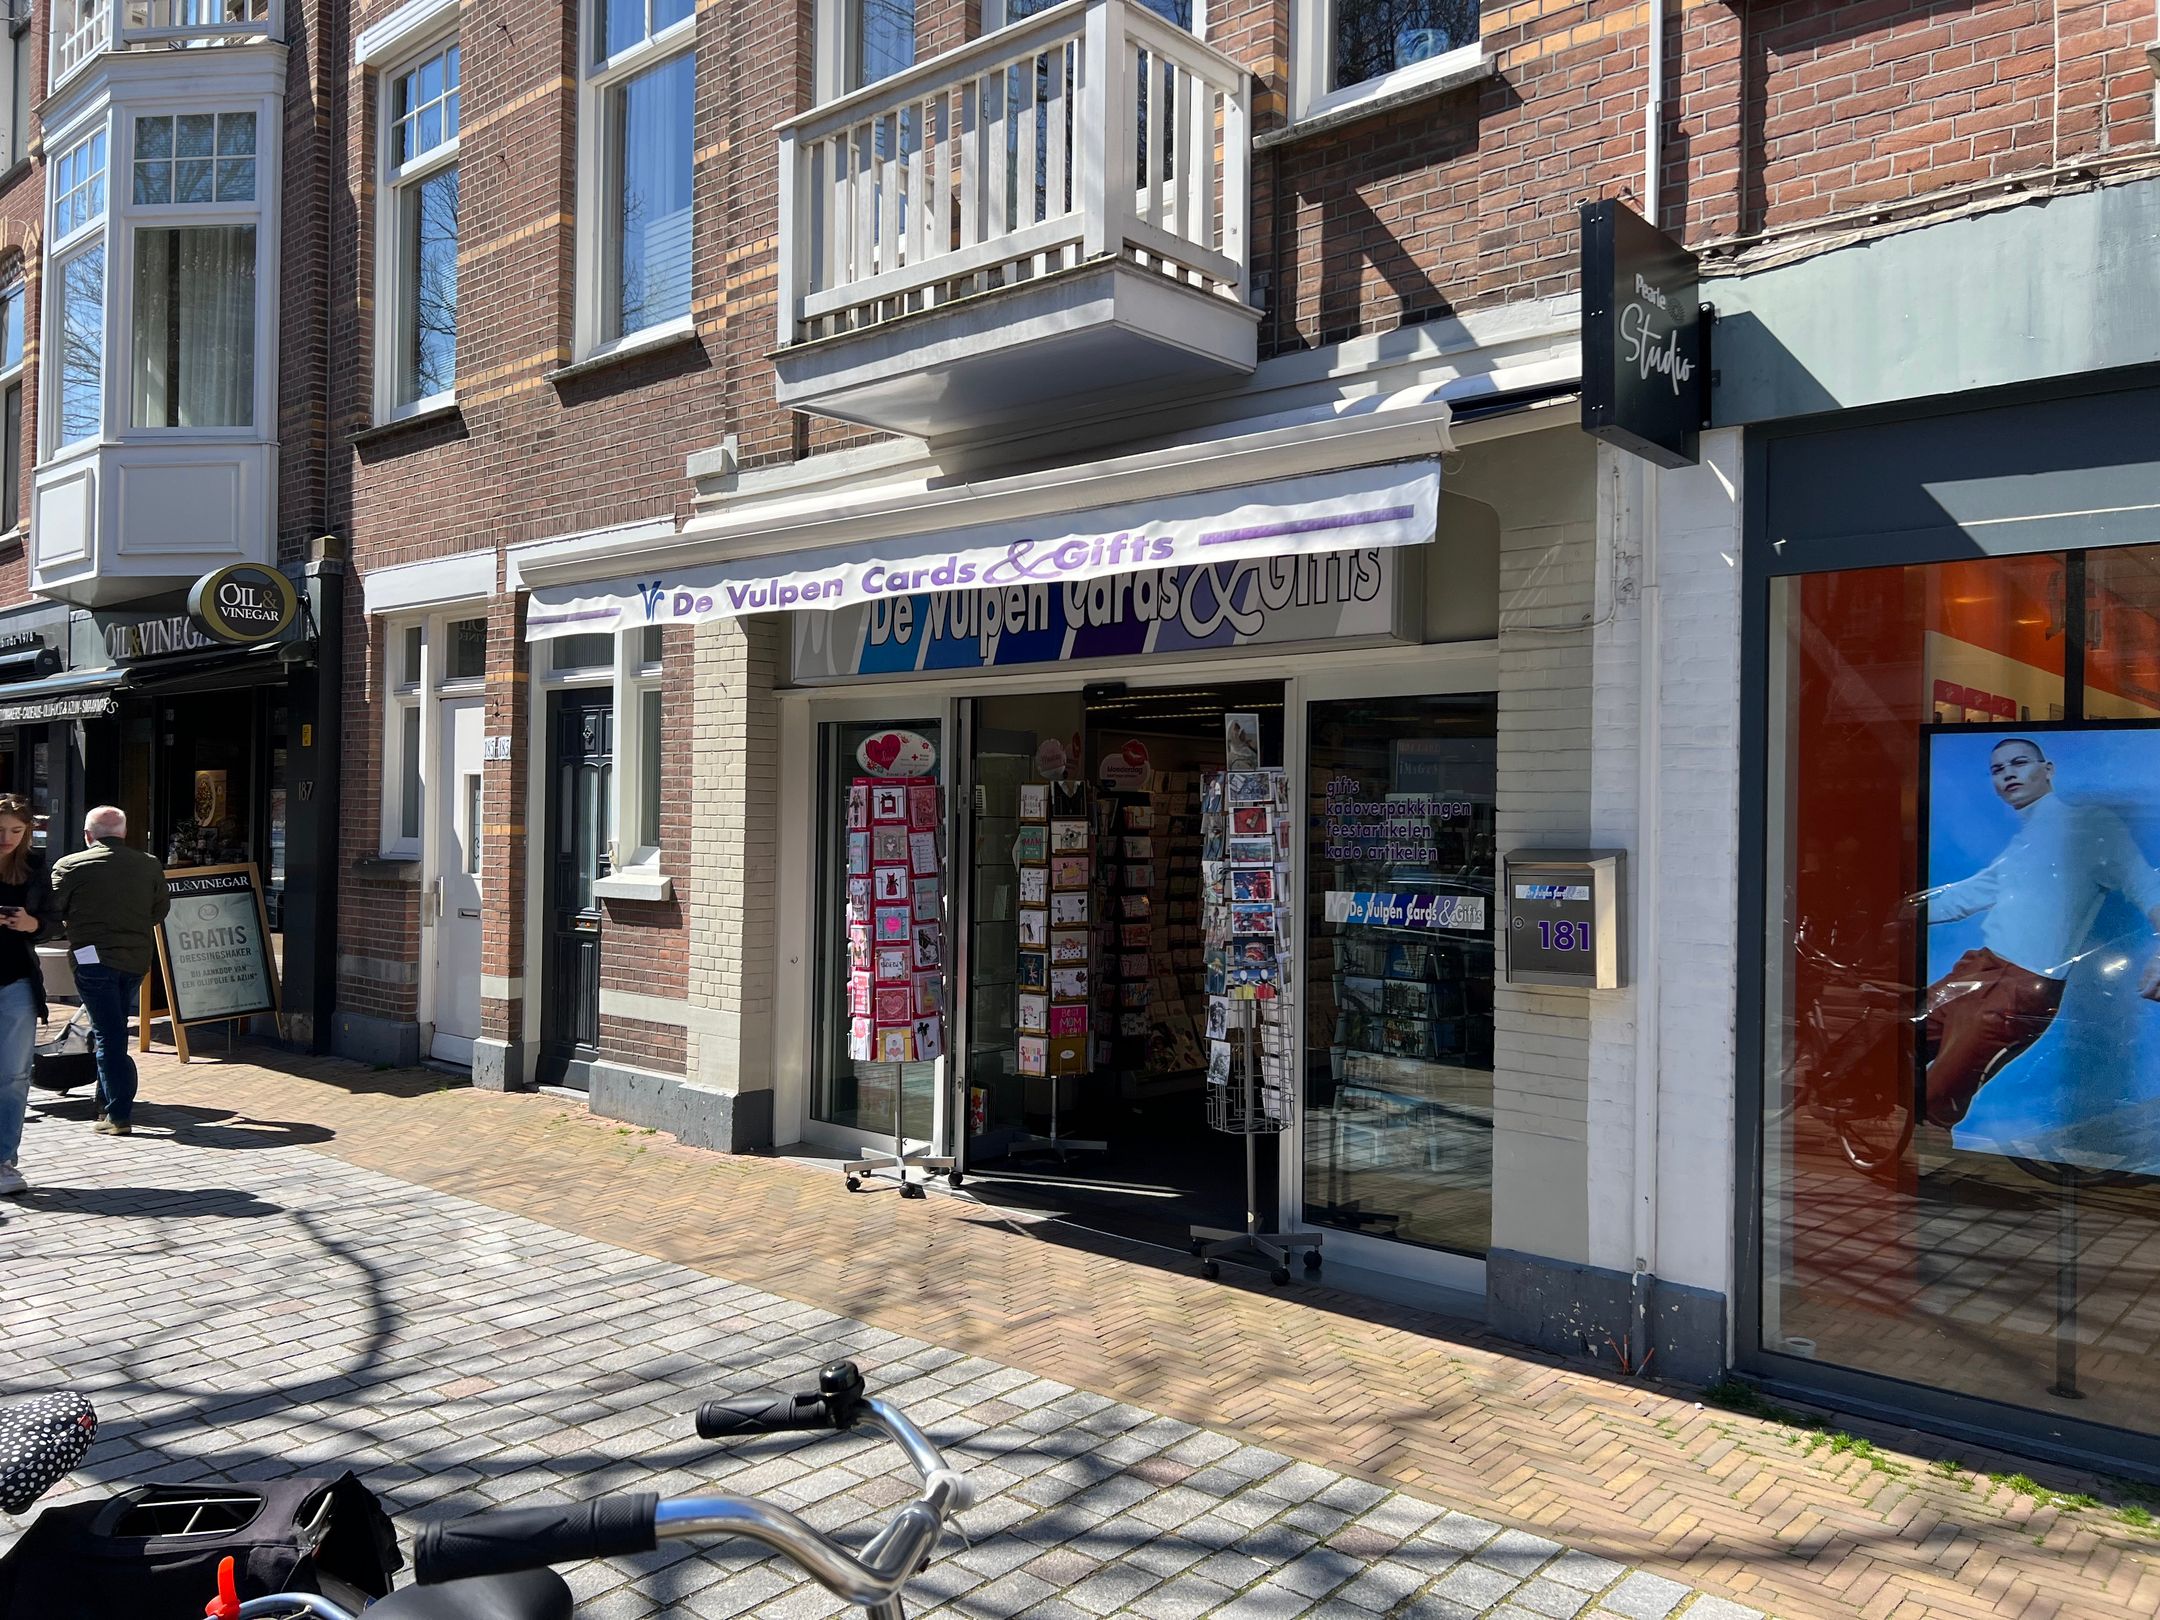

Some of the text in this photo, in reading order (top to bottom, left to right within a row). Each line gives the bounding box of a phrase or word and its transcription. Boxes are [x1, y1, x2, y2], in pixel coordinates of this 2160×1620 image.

[1635, 273, 1667, 310] Pearle
[1619, 303, 1696, 395] Studio
[673, 592, 713, 617] De
[726, 575, 843, 610] Vulpen
[861, 556, 977, 593] Cards
[1053, 532, 1174, 570] Gifts
[220, 606, 280, 622] VINEGAR
[870, 595, 914, 646] De
[929, 582, 1048, 658] Vulpen
[104, 616, 216, 660] OIL&VINEG
[1325, 776, 1360, 797] gifts
[1325, 798, 1472, 820] kadoverpakkingen
[1325, 820, 1431, 838] feestartikelen
[1324, 840, 1438, 861] kado artikelen
[1349, 902, 1363, 917] De
[1367, 901, 1403, 925] Vulpen
[1406, 901, 1437, 920] Cards
[1456, 904, 1482, 923] Gifts
[179, 926, 247, 950] GRATIS
[1538, 919, 1590, 952] 181
[180, 947, 252, 964] DRESSINGSHAKER
